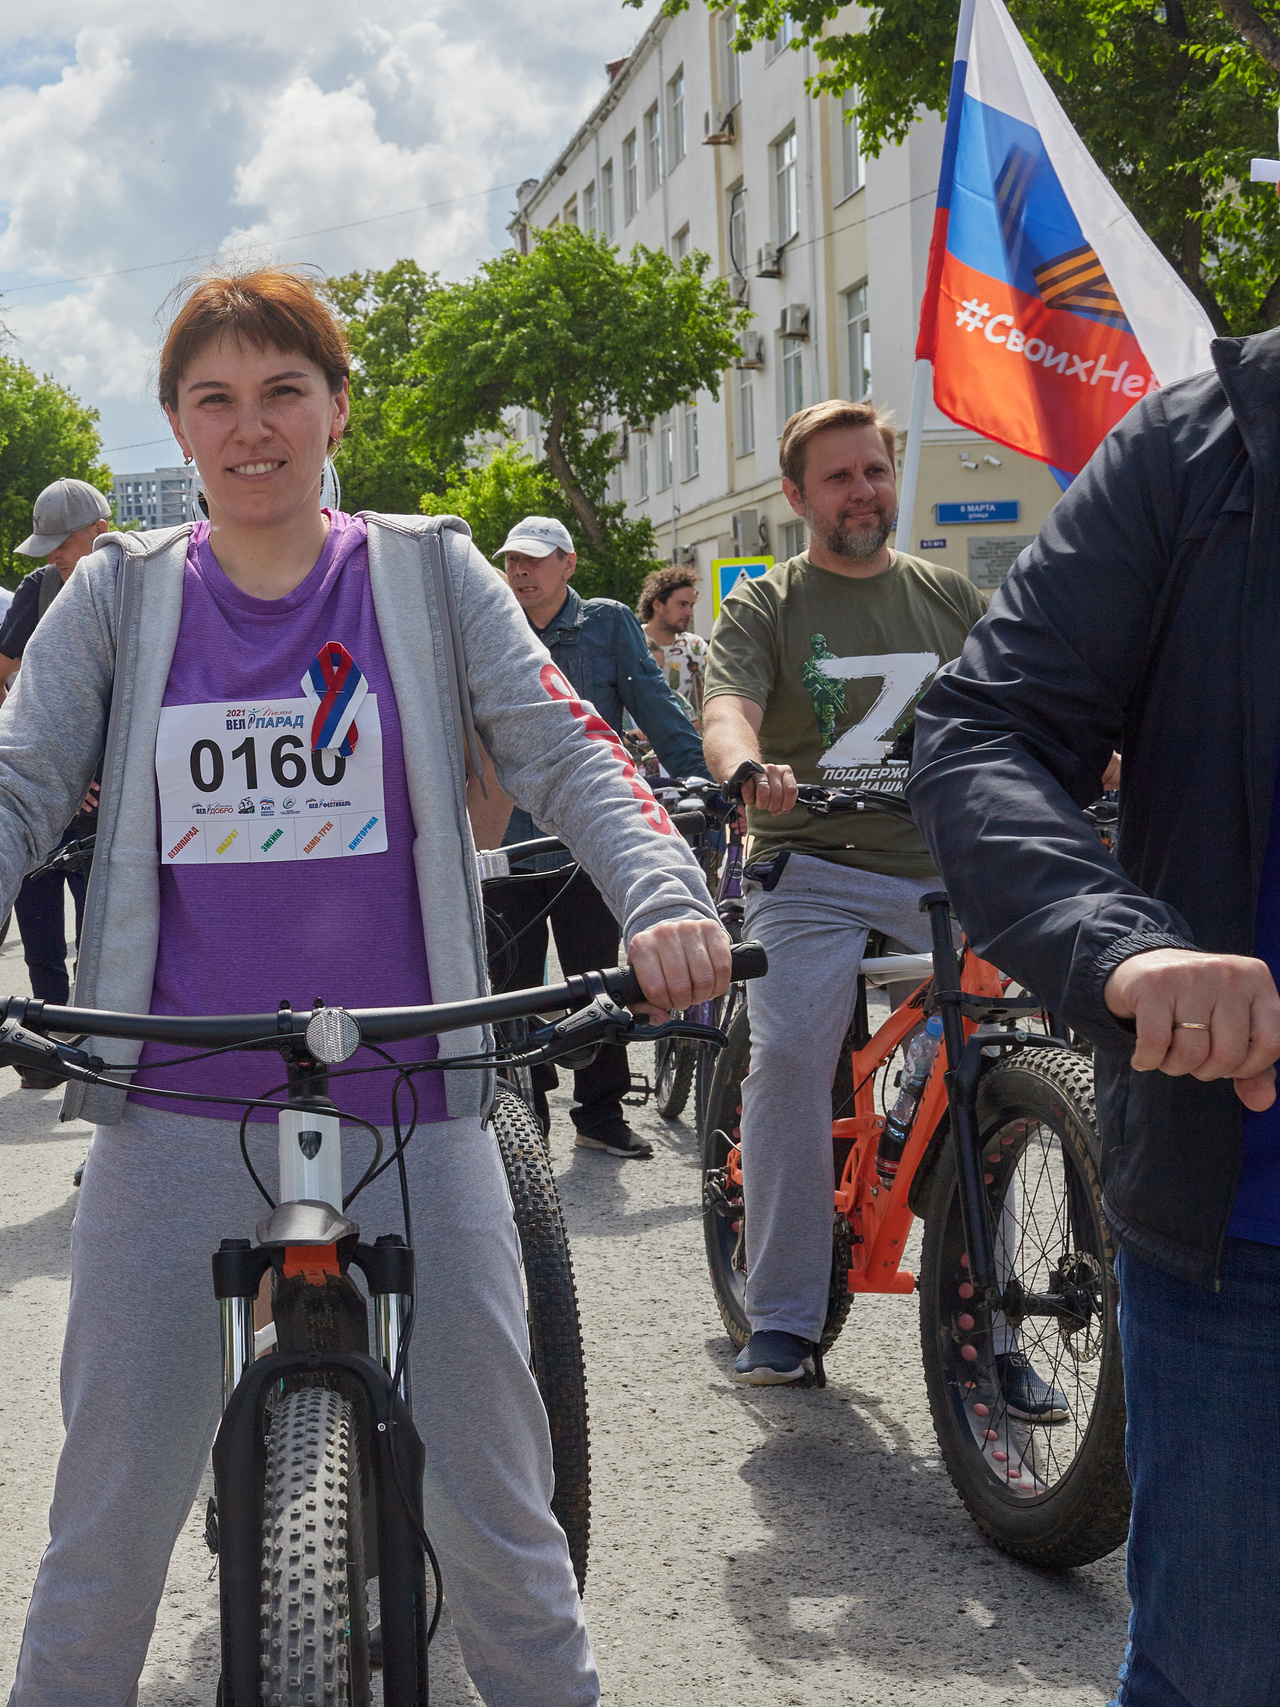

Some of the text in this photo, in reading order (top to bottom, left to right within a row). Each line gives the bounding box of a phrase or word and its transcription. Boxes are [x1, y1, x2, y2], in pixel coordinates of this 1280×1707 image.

[967, 503, 996, 512] МАРТА
[968, 512, 989, 520] улица
[226, 709, 245, 717] 2021
[816, 651, 940, 768] Z
[190, 734, 347, 793] 0160
[167, 826, 200, 859] ВЕЛОПАРАД
[215, 828, 240, 856] КВАДРАТ
[260, 828, 285, 853] ЗМЕЙКА
[303, 820, 334, 855] ПАМП-ТРЕК
[347, 816, 379, 851] ВИКТОРИНА
